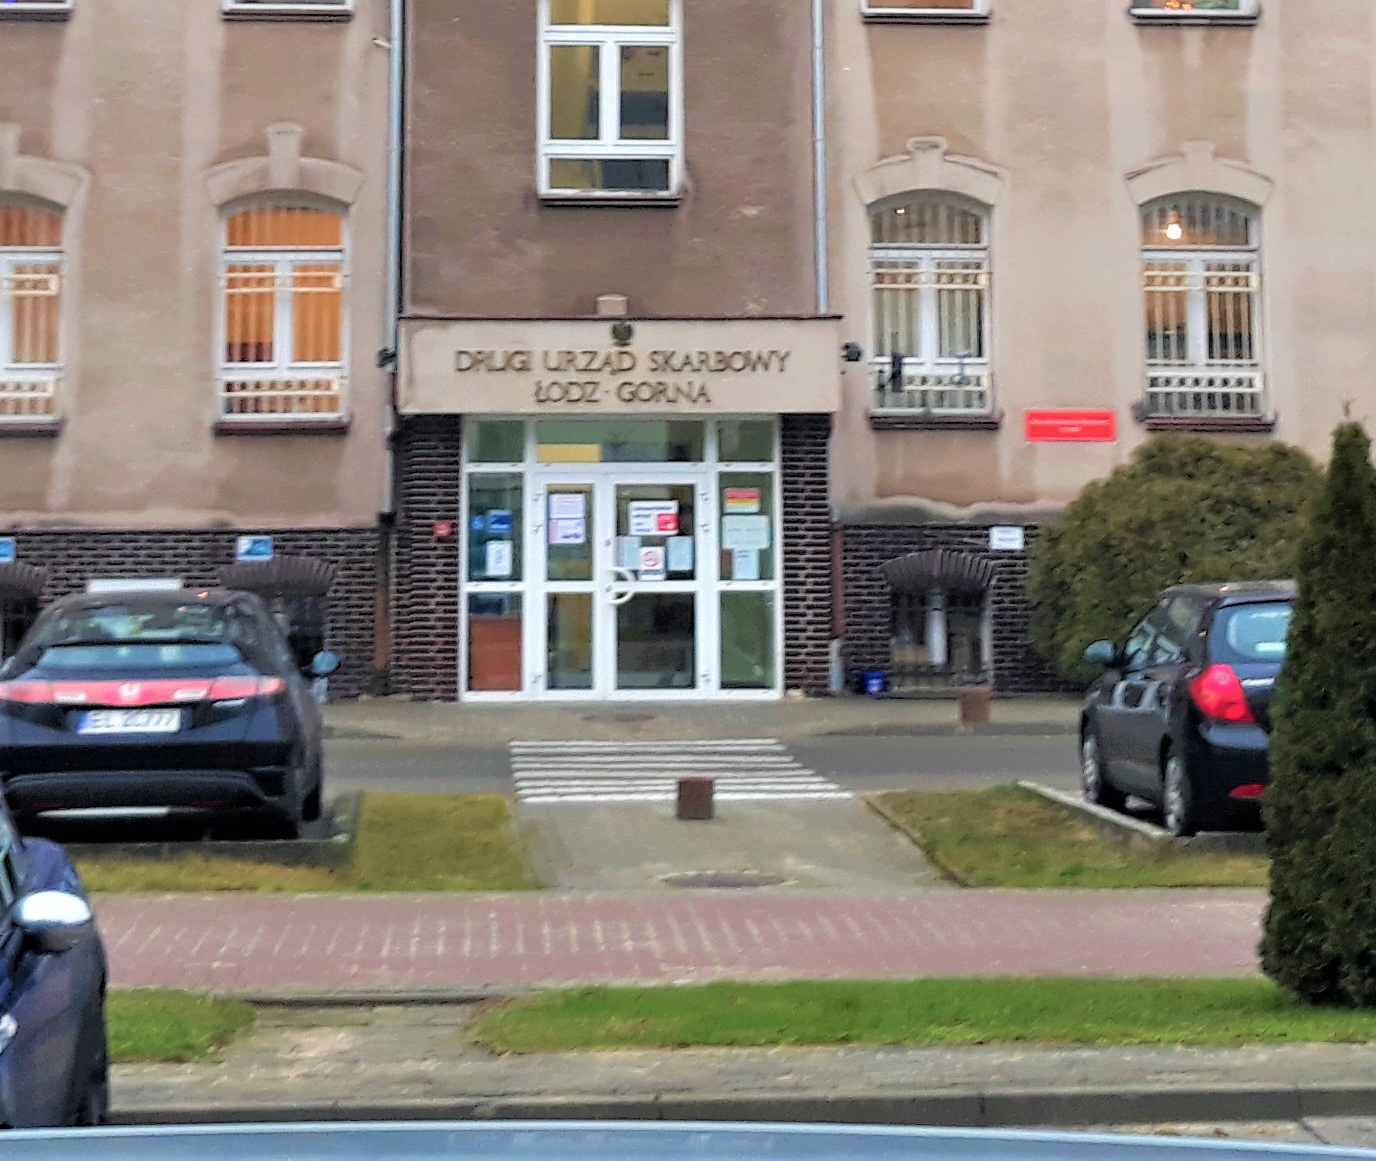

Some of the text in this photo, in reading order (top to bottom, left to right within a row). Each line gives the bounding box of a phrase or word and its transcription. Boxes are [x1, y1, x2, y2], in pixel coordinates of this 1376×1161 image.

[455, 350, 791, 376] DRUGI URZĄD SKARBOWY
